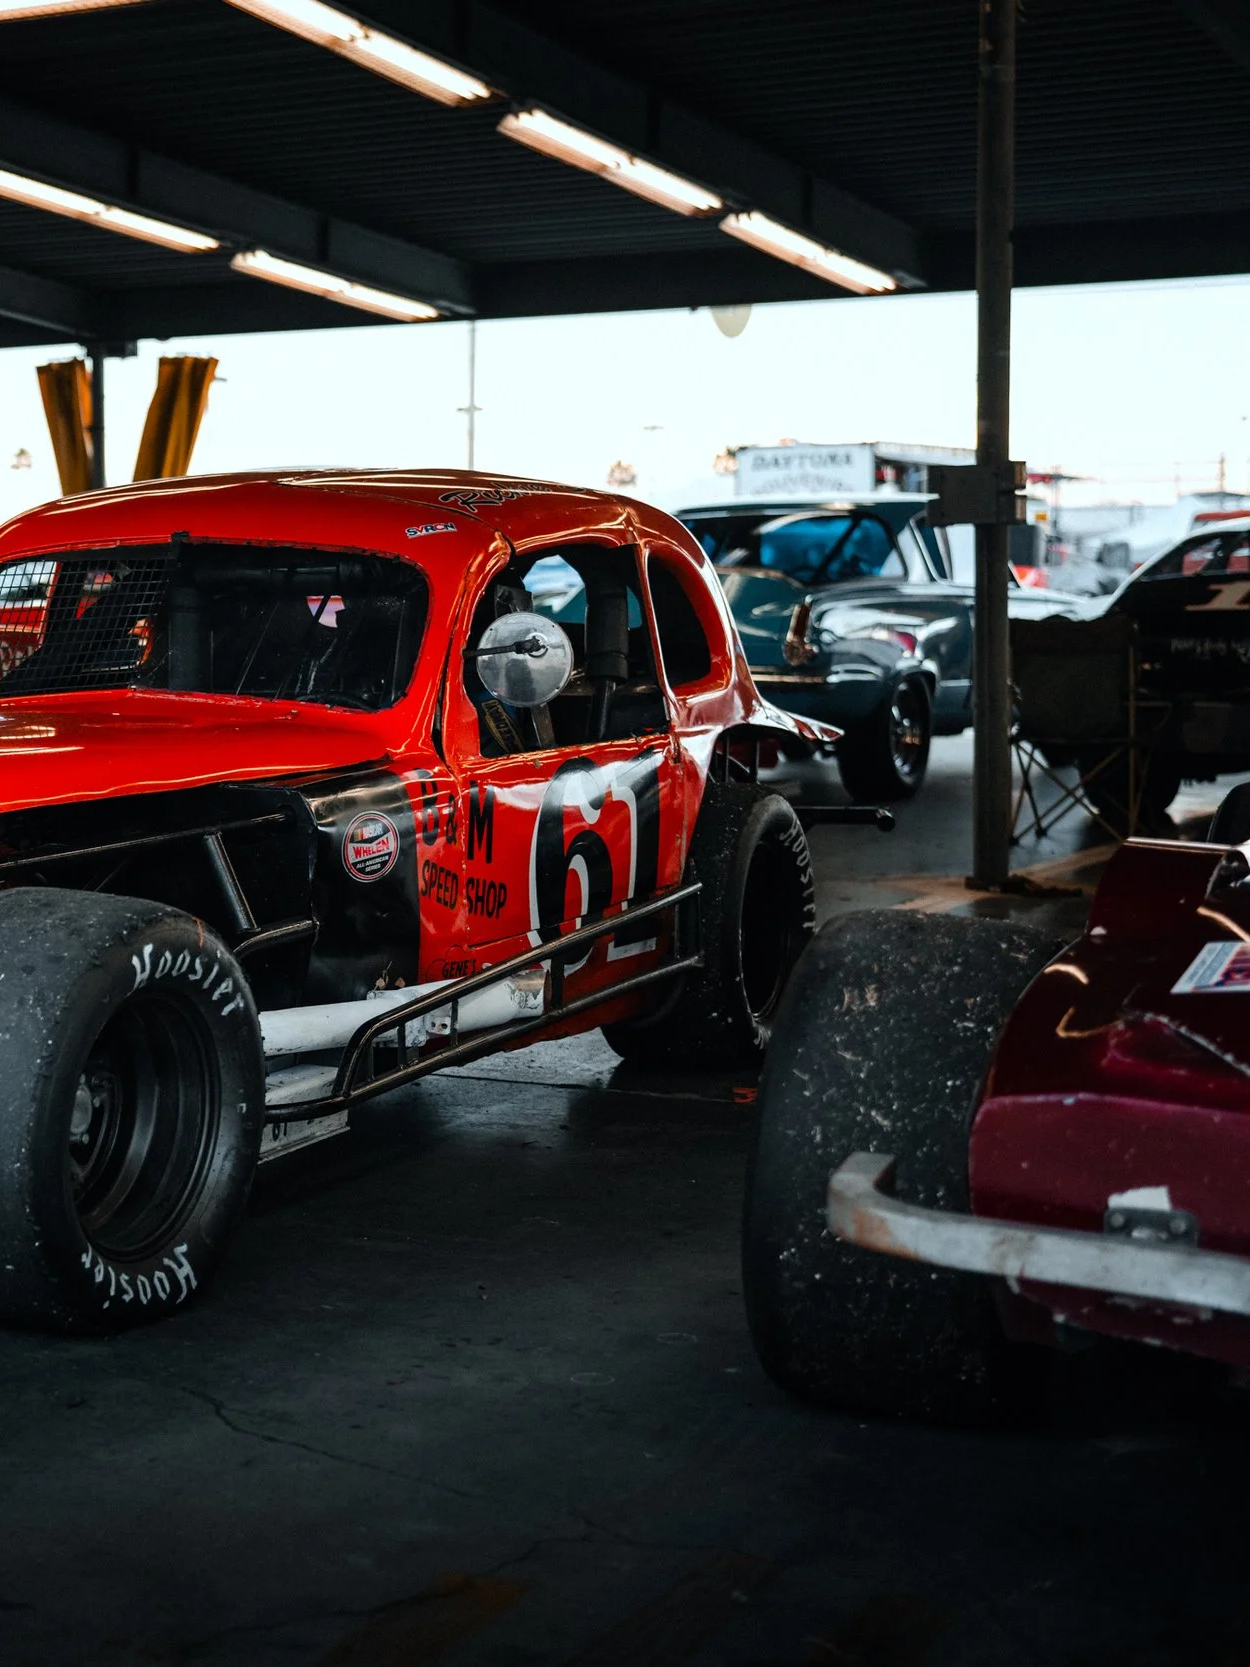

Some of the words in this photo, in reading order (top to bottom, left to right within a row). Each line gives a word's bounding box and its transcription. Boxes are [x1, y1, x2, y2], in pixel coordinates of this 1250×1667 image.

[353, 836, 390, 859] WHELEN
[419, 767, 440, 846] B
[445, 794, 458, 845] &
[467, 780, 496, 864] M
[421, 859, 459, 911] SPEED
[465, 877, 507, 920] SHOP
[125, 943, 245, 1016] Hoosier
[80, 1243, 198, 1310] Hoosier
